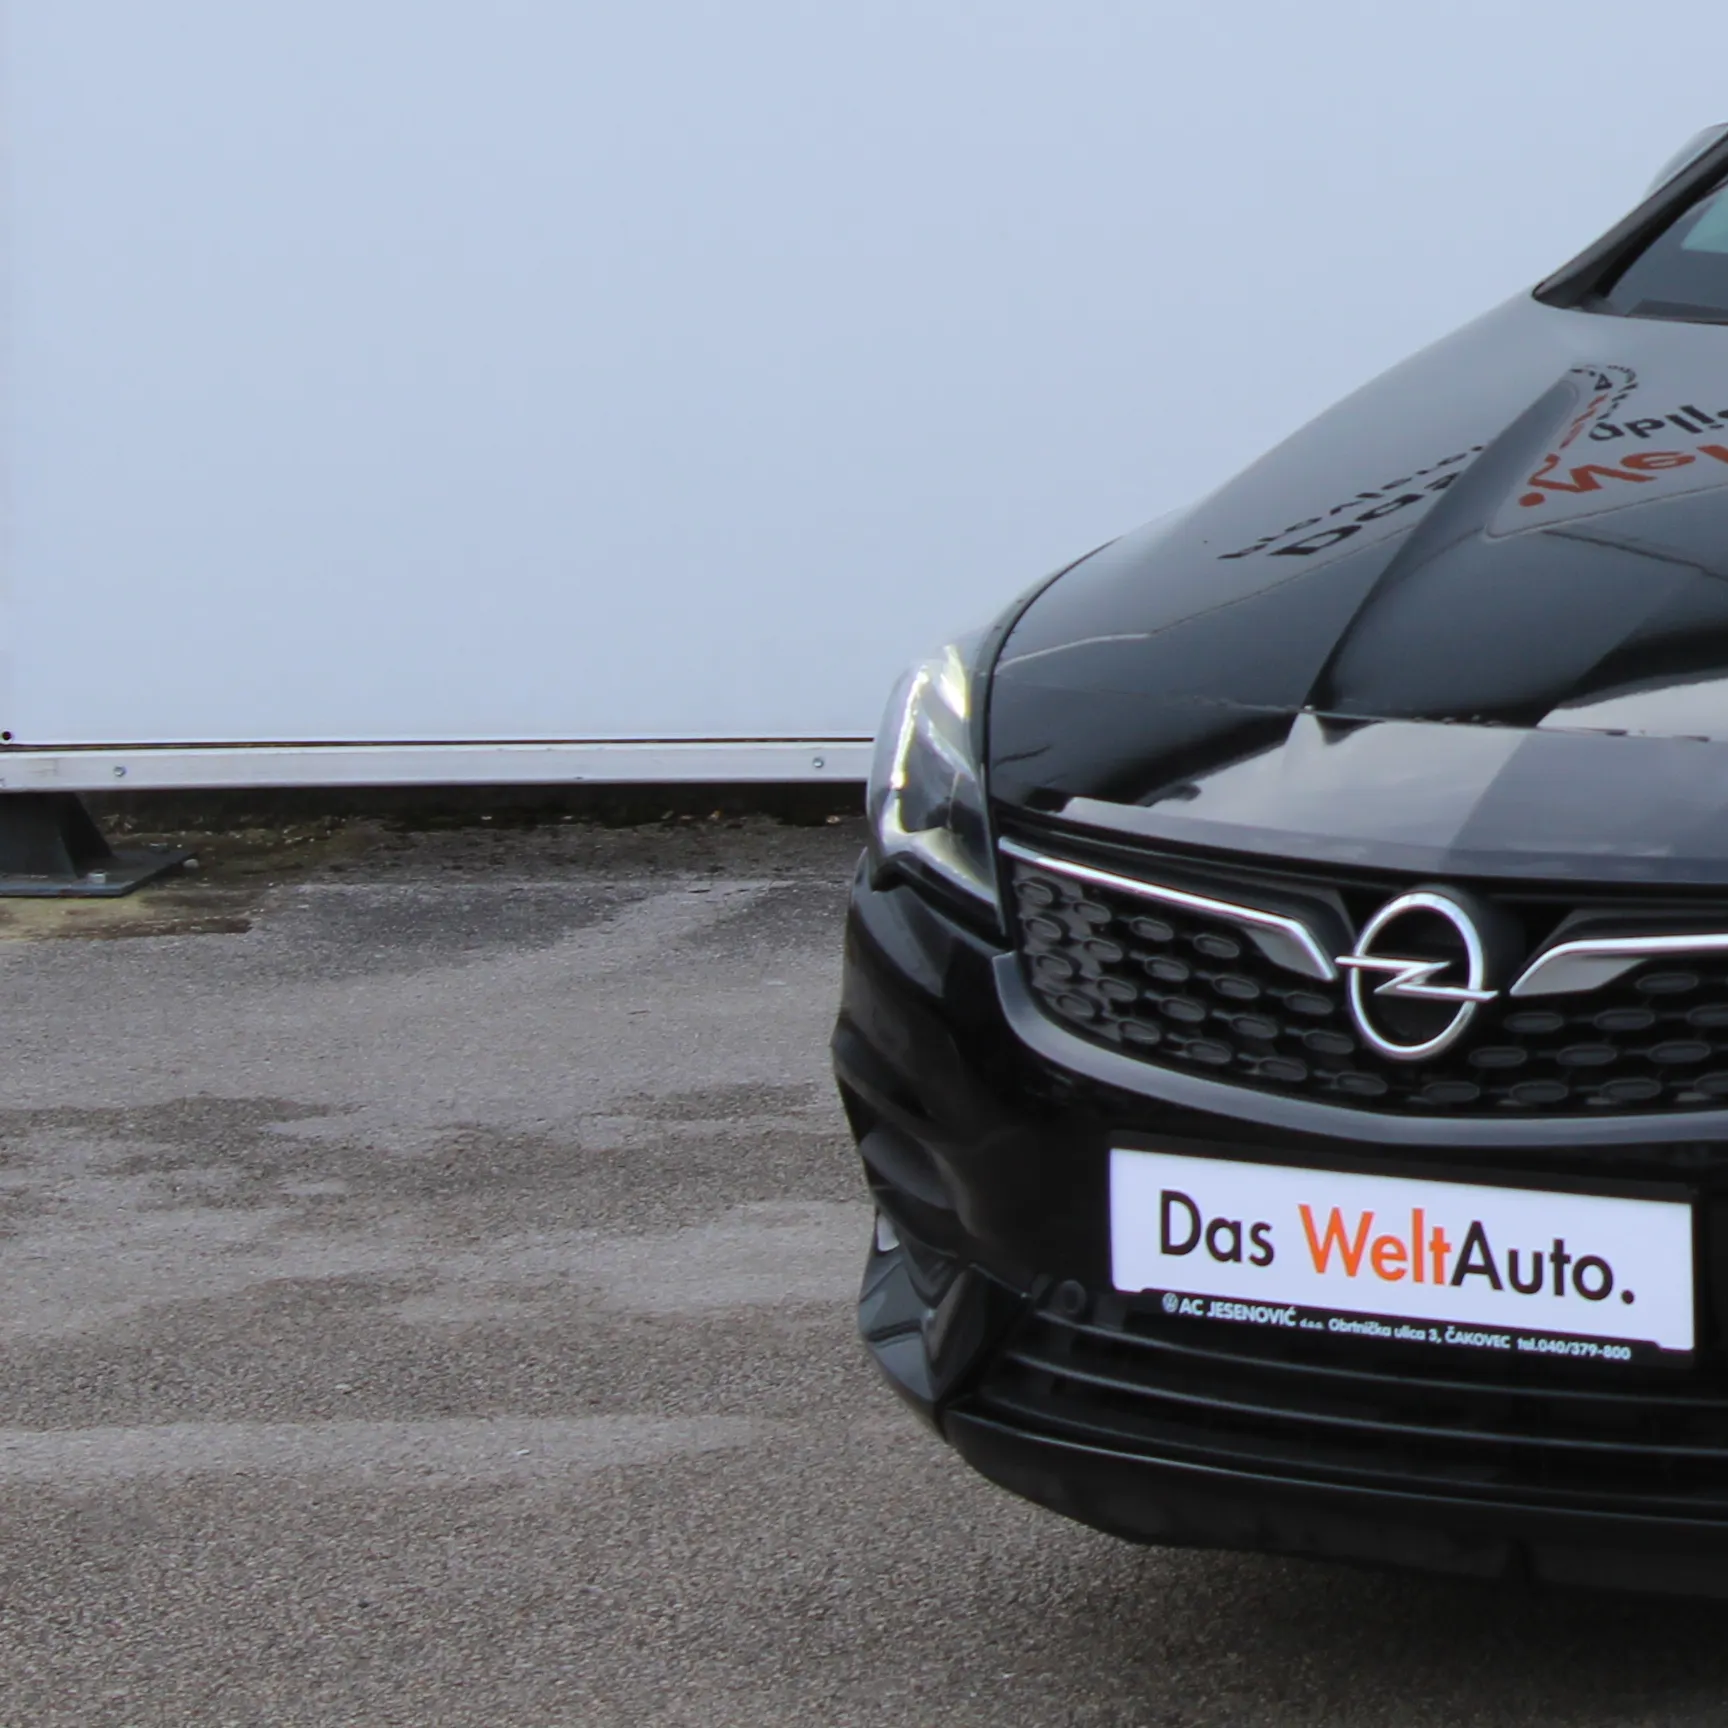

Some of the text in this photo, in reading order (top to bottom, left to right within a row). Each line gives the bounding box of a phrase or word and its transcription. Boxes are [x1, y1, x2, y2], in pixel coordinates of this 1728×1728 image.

[1159, 1188, 1636, 1305] Das WeltAuto.
[1179, 1298, 1204, 1315] AC
[1207, 1301, 1297, 1326] JESENOVIĆ
[1394, 1325, 1426, 1341] ulica
[1445, 1326, 1511, 1349] ČAKOVEC
